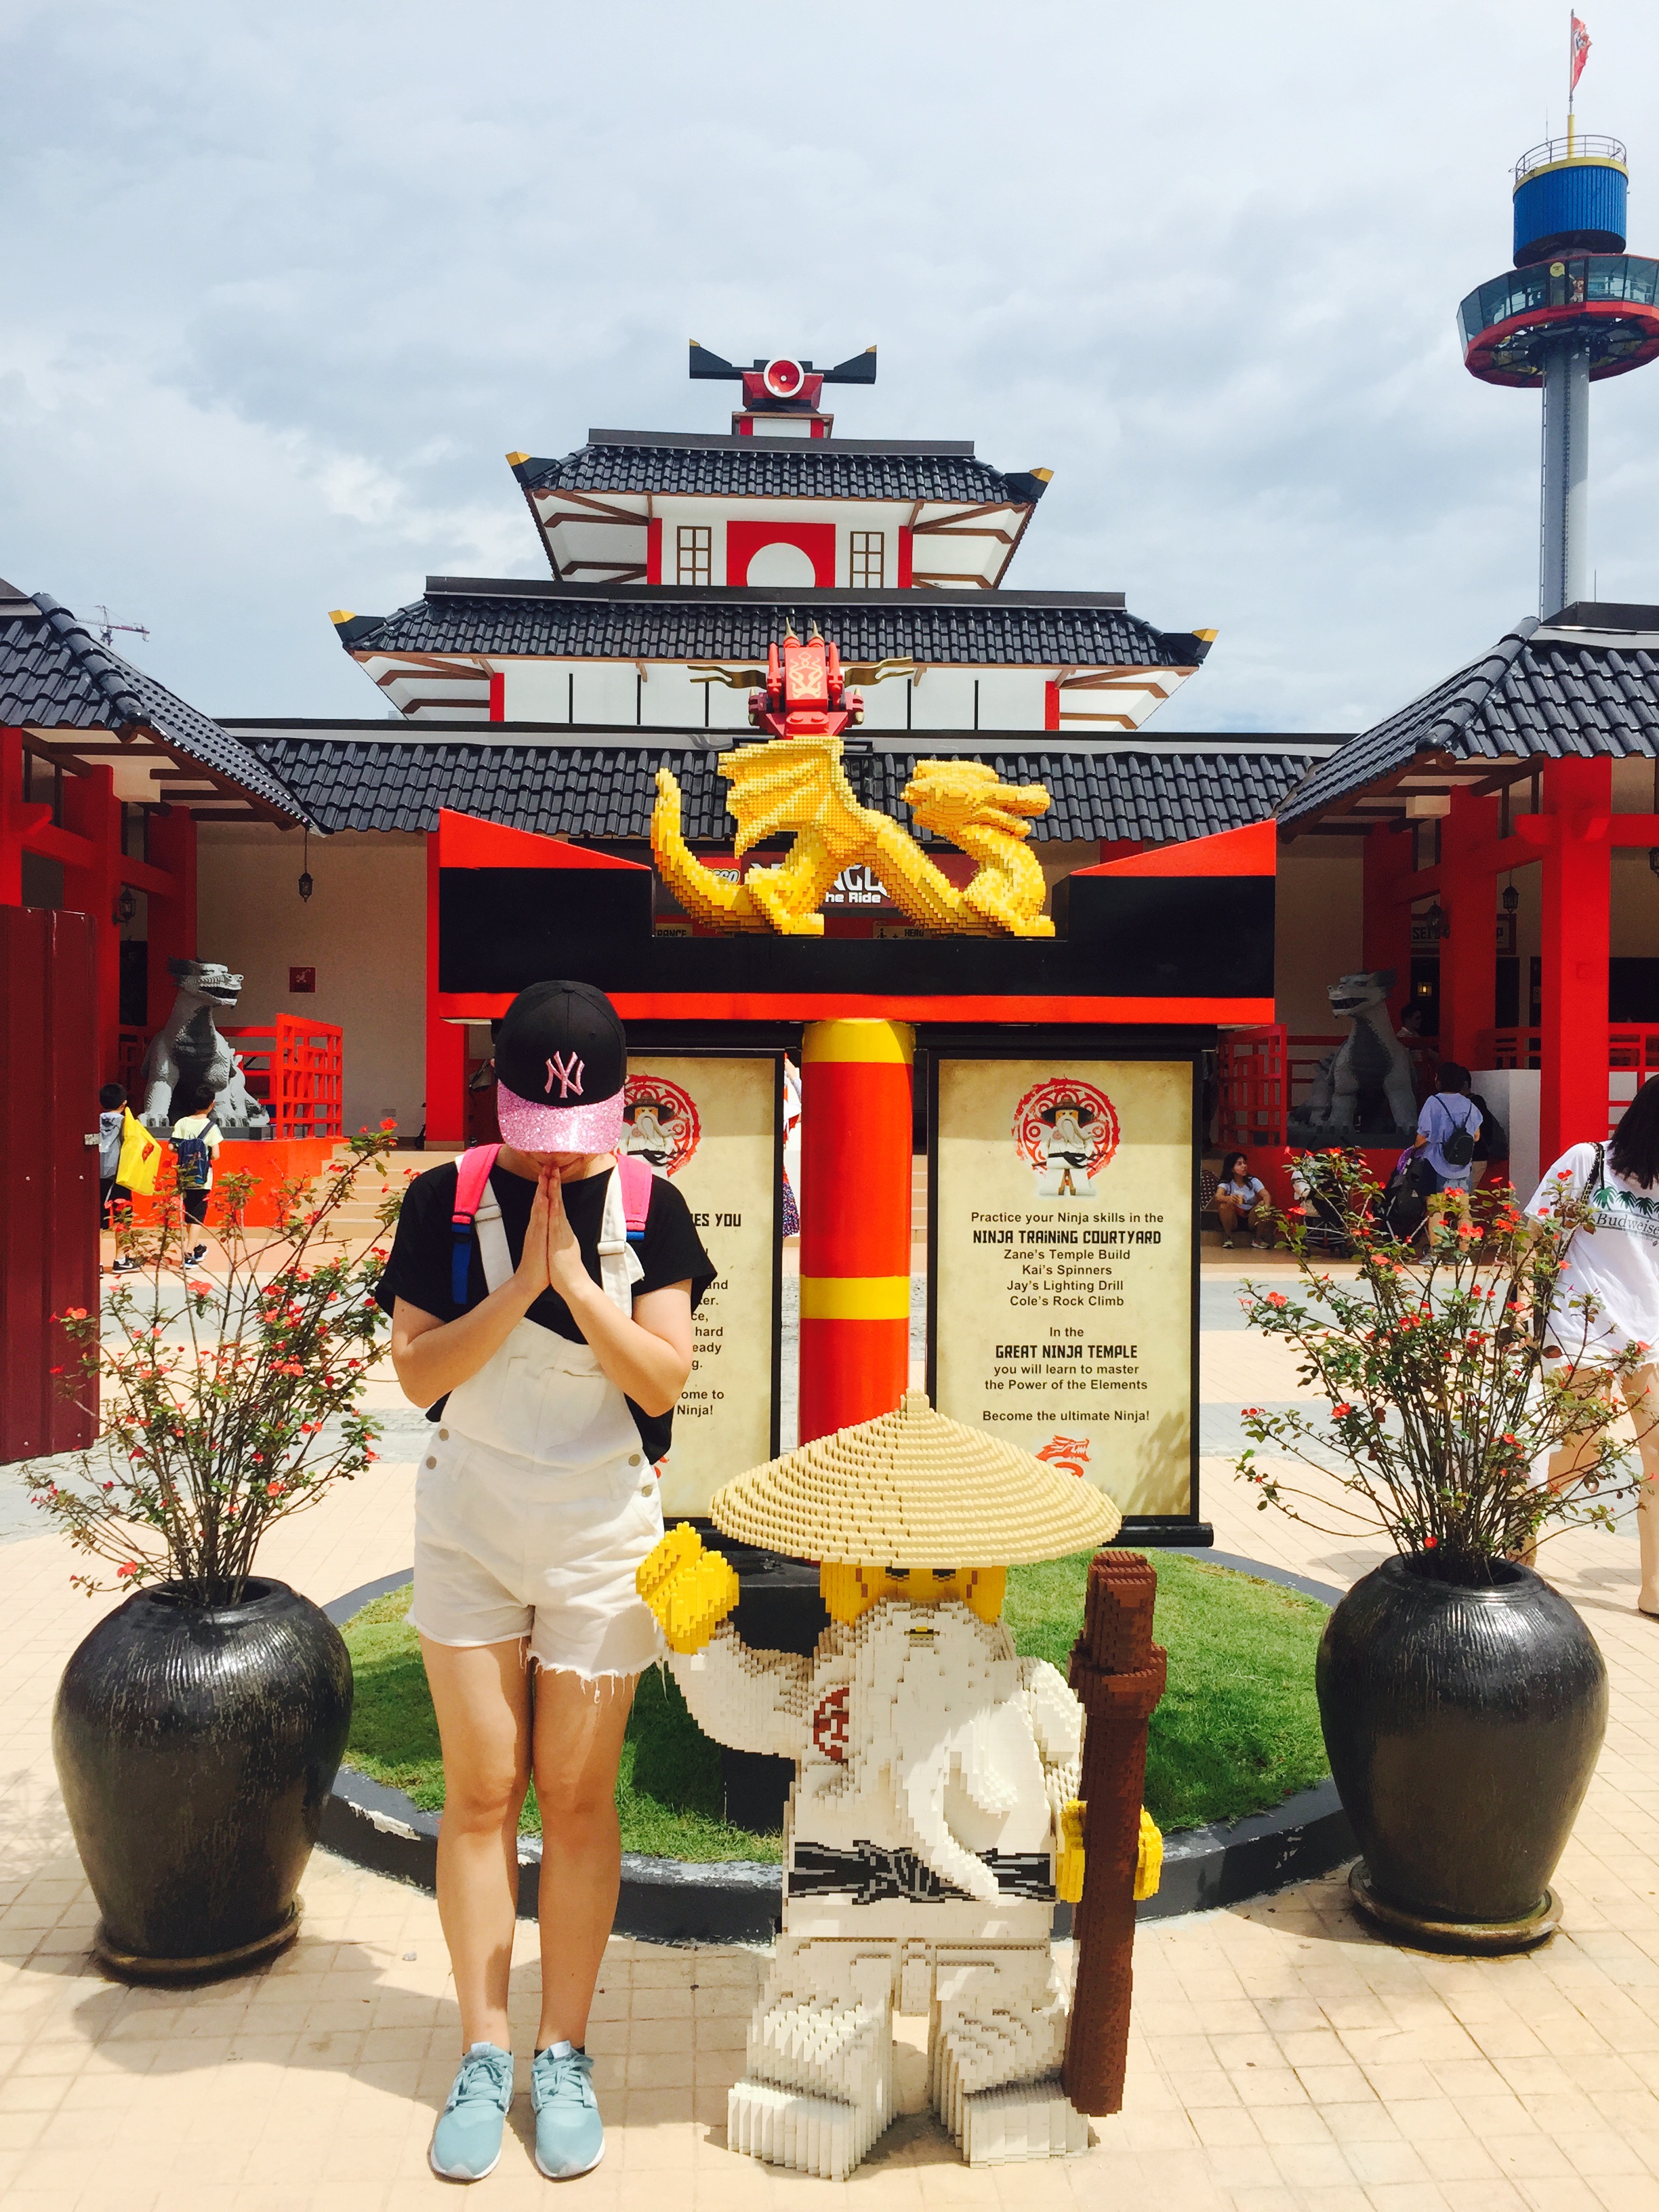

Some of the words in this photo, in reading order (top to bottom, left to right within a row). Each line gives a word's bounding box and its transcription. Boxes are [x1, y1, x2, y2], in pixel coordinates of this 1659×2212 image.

[825, 891, 844, 903] he
[848, 892, 881, 903] Ride
[715, 1213, 741, 1227] YOU
[971, 1212, 1021, 1223] Practice
[1025, 1214, 1054, 1225] your
[1058, 1212, 1089, 1225] Ninja
[1093, 1212, 1126, 1223] skills
[1130, 1212, 1141, 1223] in
[1145, 1212, 1164, 1223] the
[1597, 1213, 1659, 1235] Budweise
[973, 1230, 1013, 1244] NINJA
[1083, 1230, 1161, 1244] COURTYARD
[1004, 1249, 1045, 1259] Zane's
[1049, 1249, 1094, 1262] Temple
[1099, 1249, 1130, 1260] Build
[1023, 1265, 1052, 1275] Kai's
[1057, 1265, 1112, 1277] Spinners
[1006, 1280, 1039, 1293] Jay's
[1044, 1280, 1094, 1293] Lighting
[1099, 1280, 1123, 1290] Drill
[1010, 1296, 1048, 1306] Cole's
[1053, 1296, 1084, 1306] Rock
[1088, 1296, 1124, 1306] Climb
[695, 1326, 724, 1336] hard
[1050, 1327, 1061, 1337] In
[1065, 1327, 1084, 1337] the
[693, 1342, 722, 1355] eady
[996, 1345, 1038, 1359] GREAT
[1042, 1345, 1082, 1359] NINJA
[1087, 1345, 1137, 1358] TEMPLE
[994, 1366, 1017, 1377] you
[1021, 1364, 1042, 1374] will
[1046, 1364, 1076, 1374] learn
[1080, 1364, 1092, 1374] to
[1097, 1365, 1139, 1374] master
[985, 1379, 1004, 1390] the
[1008, 1379, 1048, 1390] Power
[1051, 1379, 1064, 1390] of
[1067, 1379, 1086, 1390] the
[1090, 1379, 1147, 1390] Elements
[712, 1390, 724, 1399] to
[677, 1405, 713, 1418] Ninja!
[983, 1410, 1033, 1421] Become
[1037, 1410, 1056, 1421] the
[1061, 1410, 1110, 1421] ultimate
[1114, 1410, 1149, 1423] Ninja!
